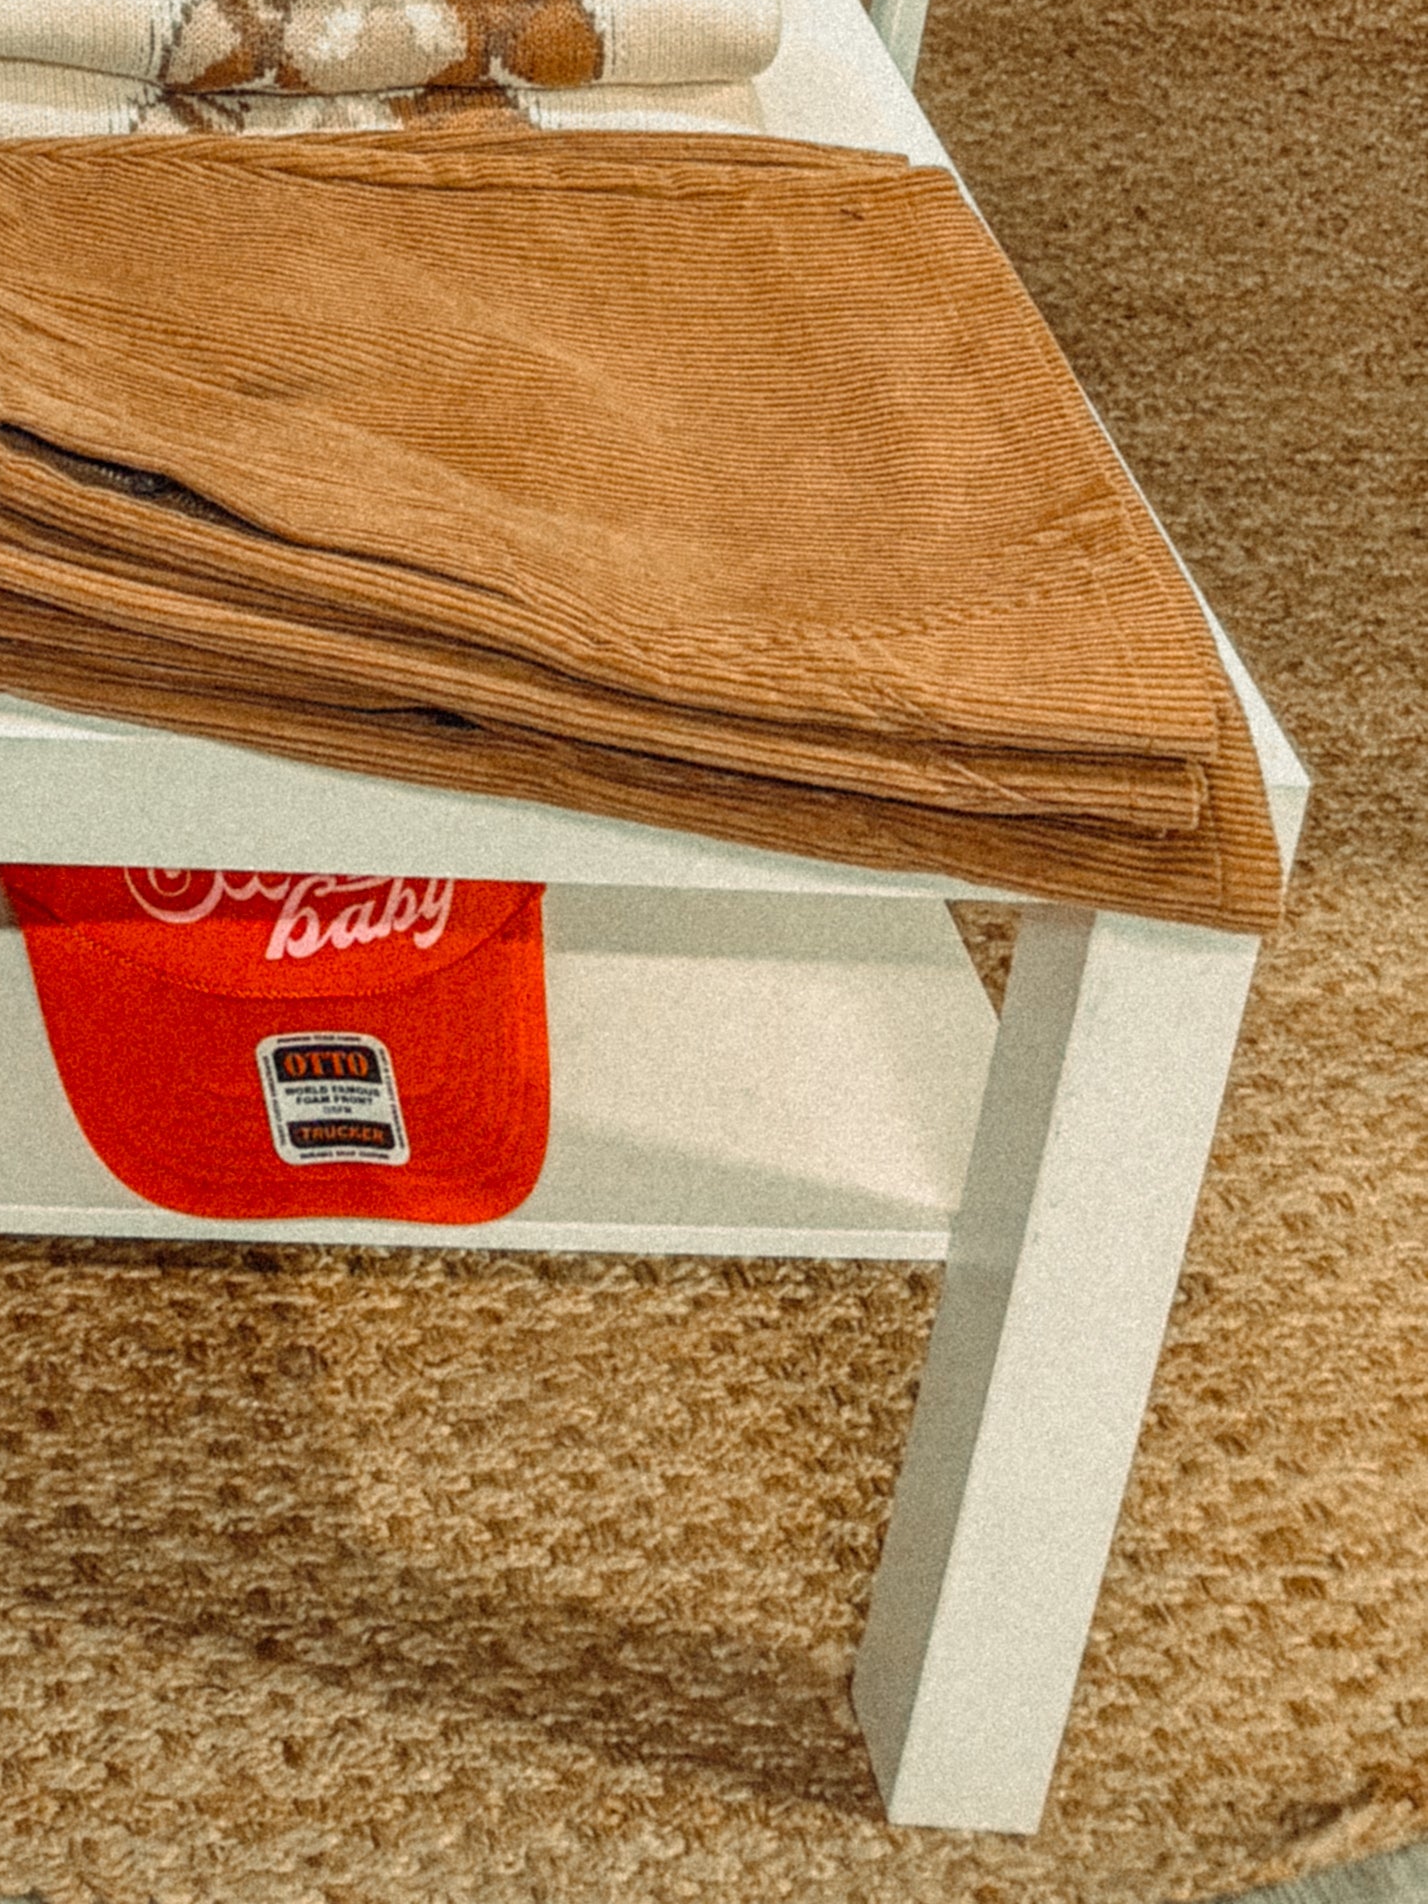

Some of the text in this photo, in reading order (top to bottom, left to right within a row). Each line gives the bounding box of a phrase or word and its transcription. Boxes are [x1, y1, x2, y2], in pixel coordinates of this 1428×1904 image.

[264, 874, 455, 960] baby
[283, 1051, 369, 1078] OTTO
[300, 1126, 385, 1142] TRUCKER
